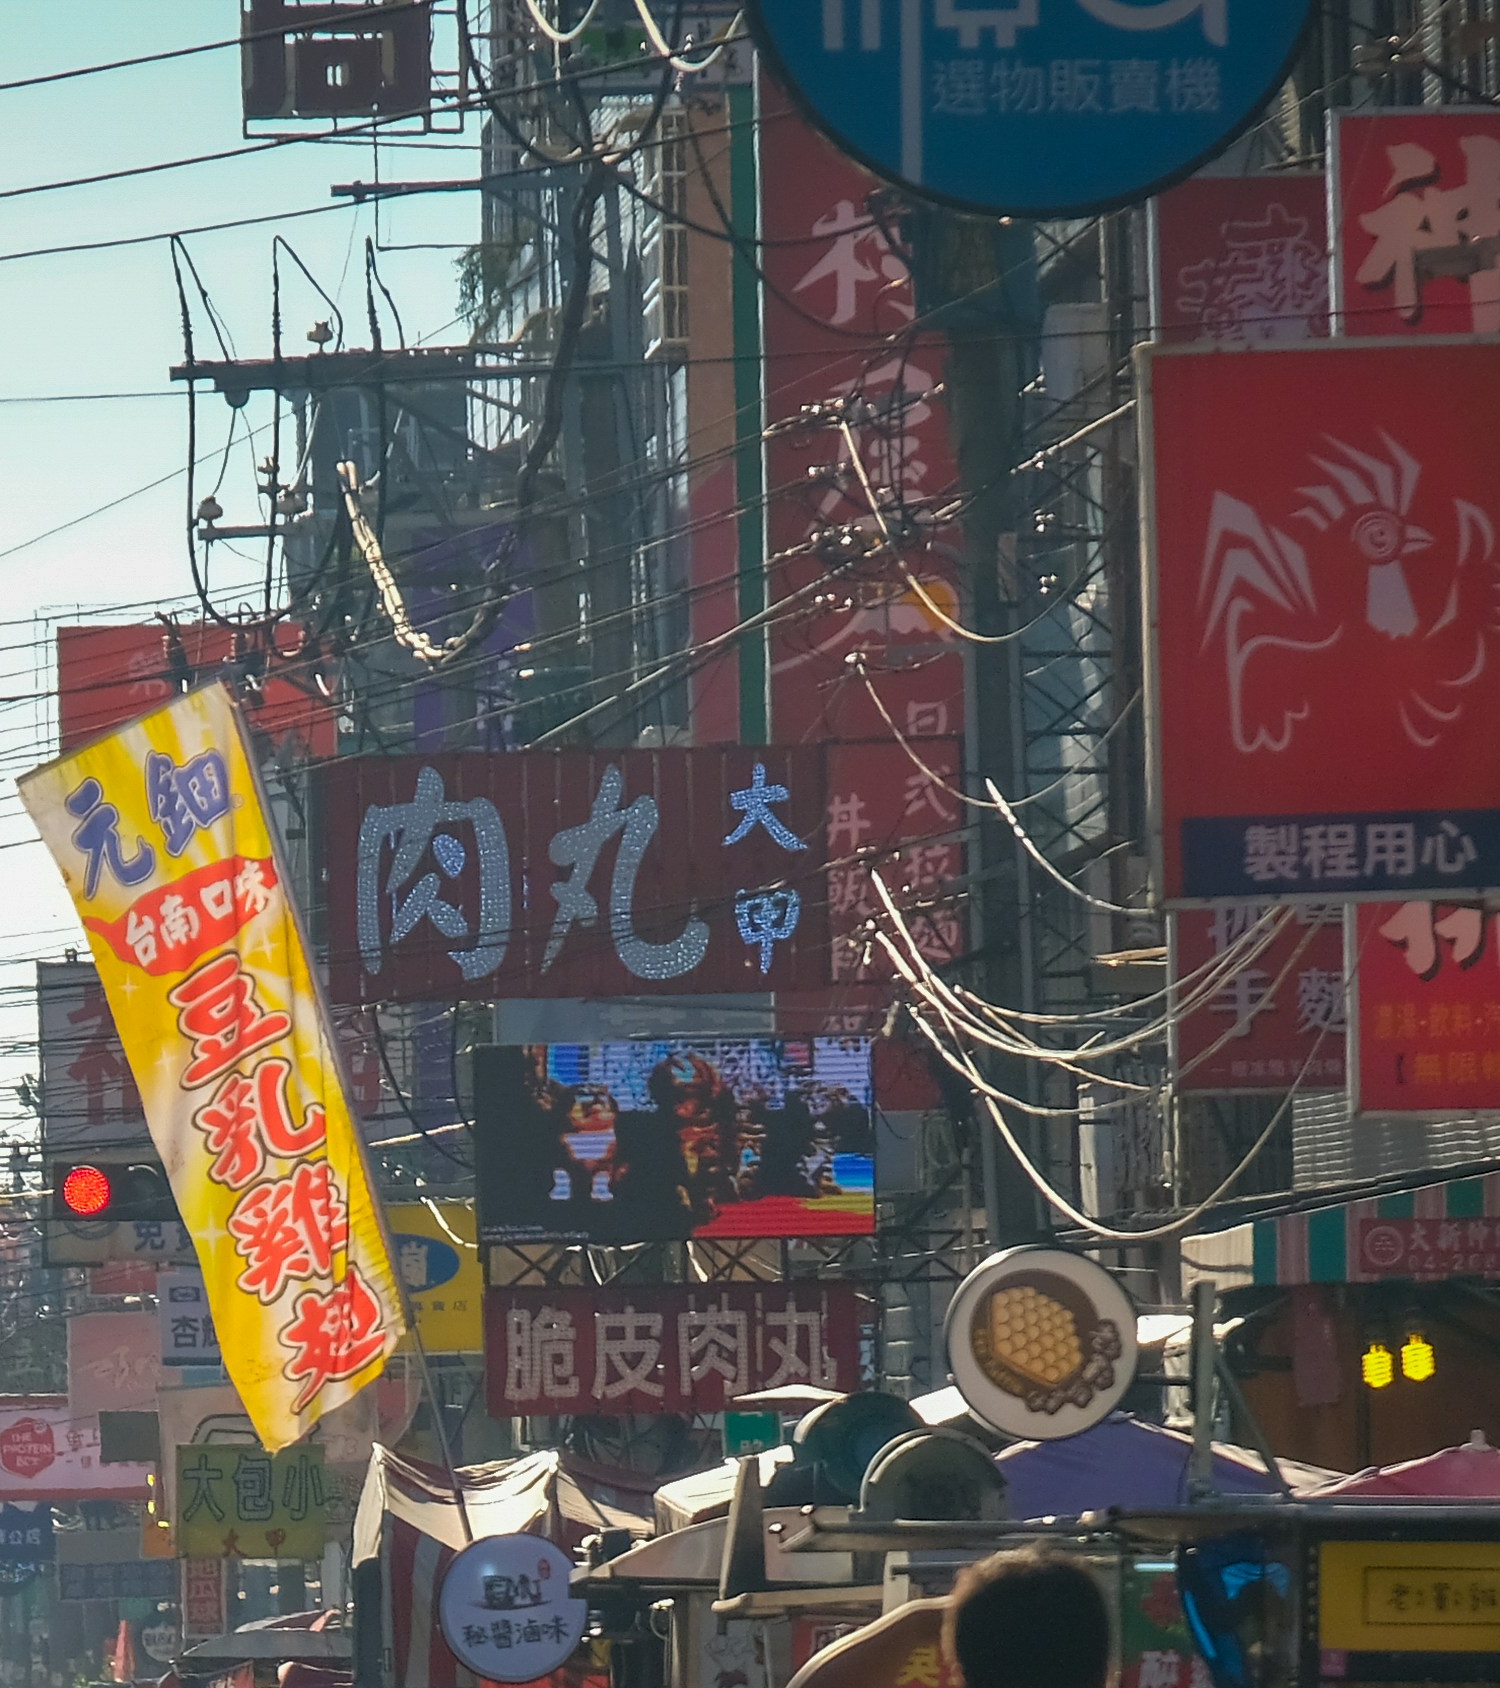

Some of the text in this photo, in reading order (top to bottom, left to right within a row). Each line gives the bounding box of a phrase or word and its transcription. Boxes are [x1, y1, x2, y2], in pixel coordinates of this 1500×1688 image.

[932, 58, 1222, 112] 選物販賣機
[356, 761, 809, 984] 肉丸 大甲
[1245, 824, 1478, 882] 製程用心
[124, 856, 278, 968] 台南口味
[169, 949, 388, 1415] 豆乳雞翅
[503, 1296, 839, 1401] 脆皮肉丸
